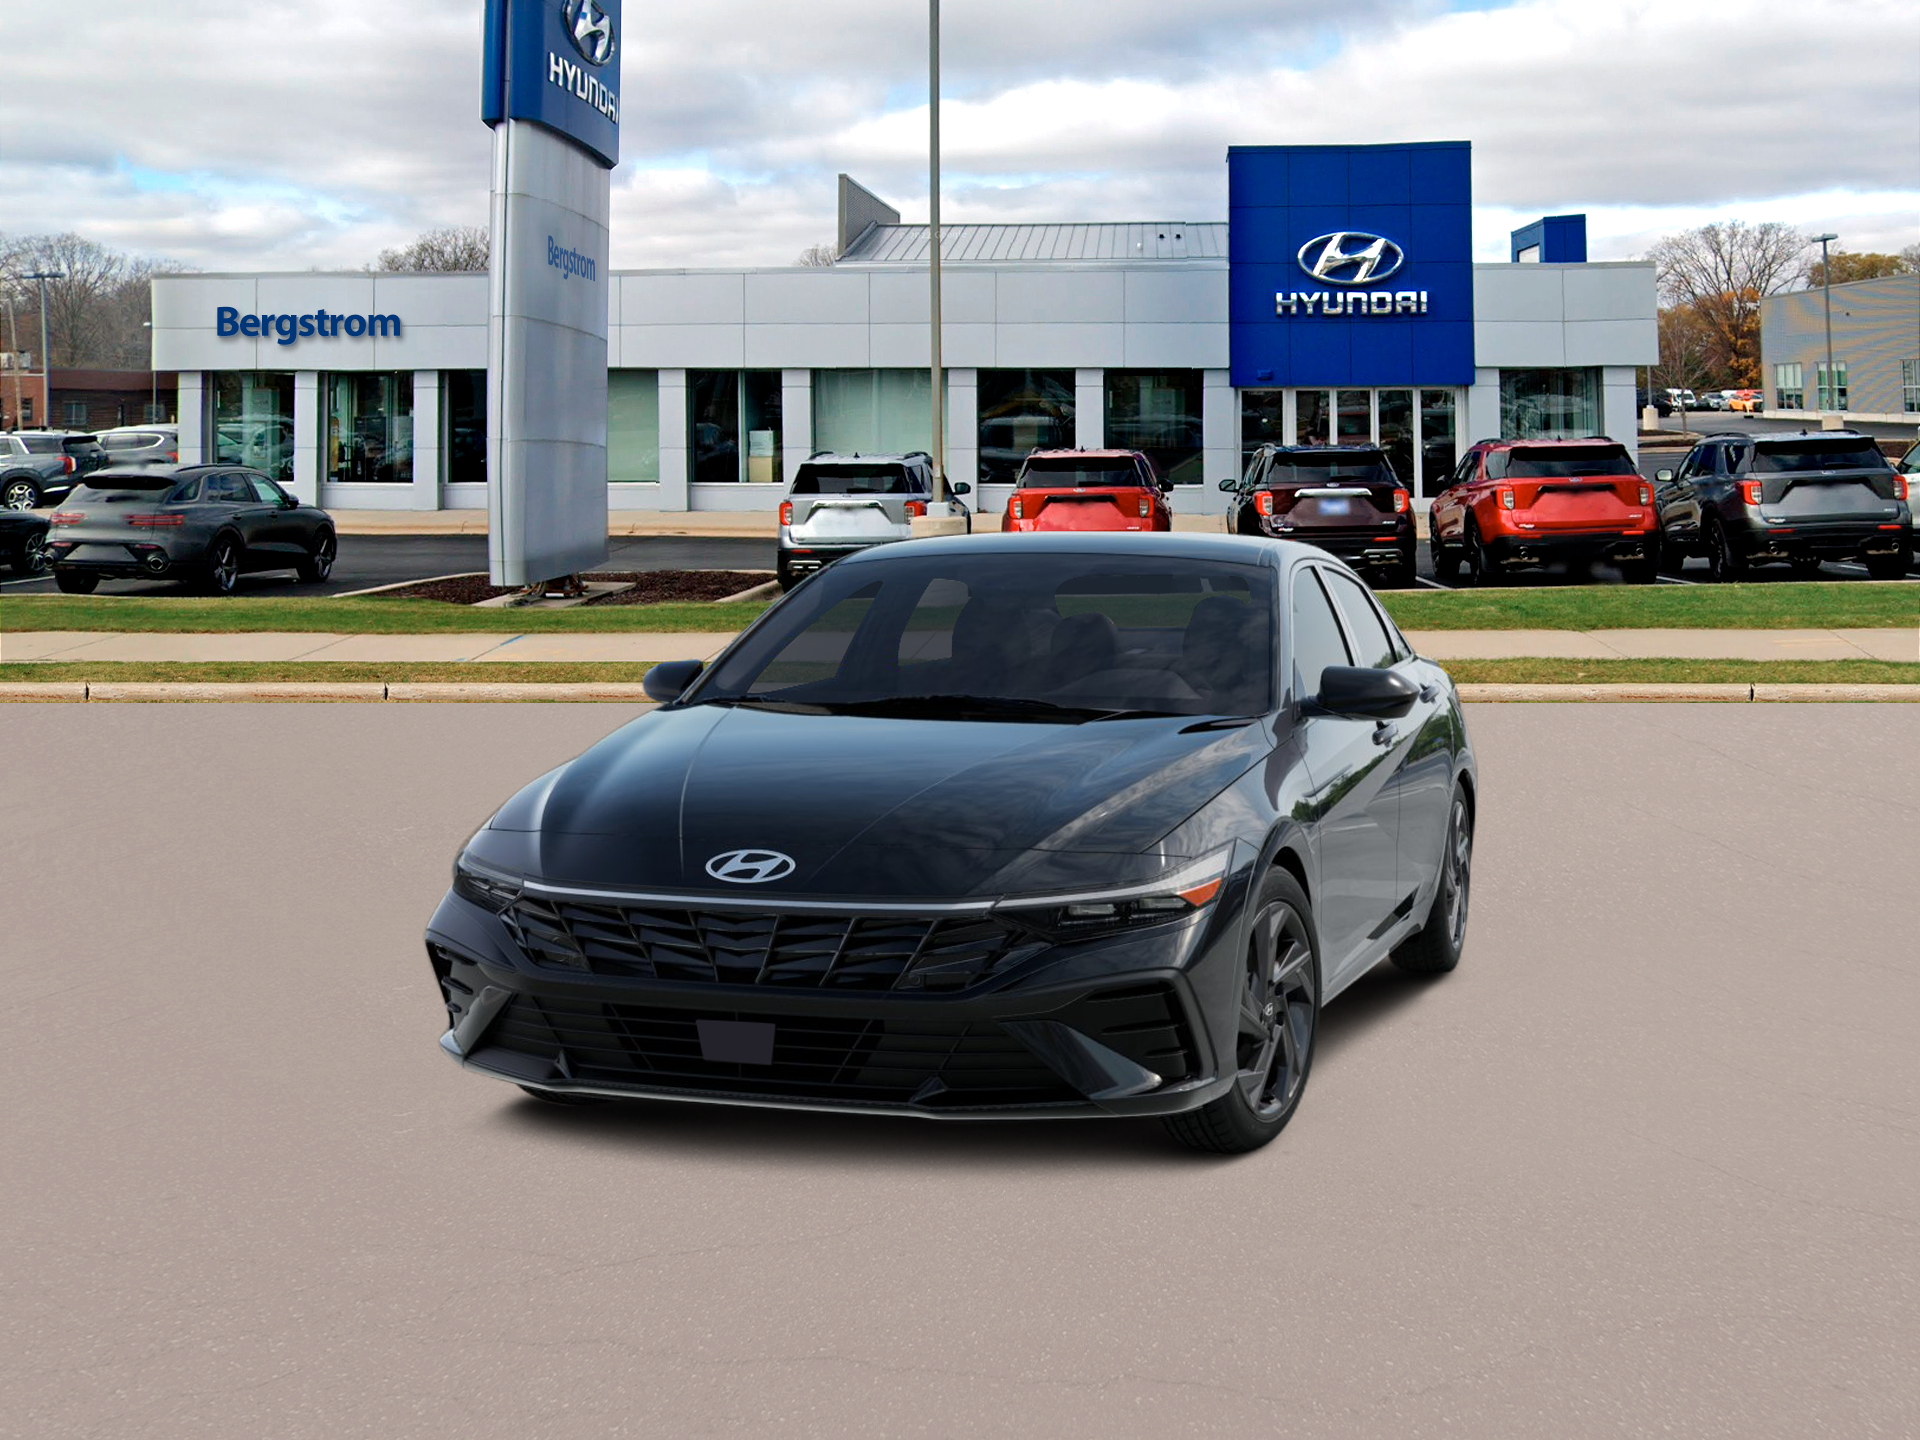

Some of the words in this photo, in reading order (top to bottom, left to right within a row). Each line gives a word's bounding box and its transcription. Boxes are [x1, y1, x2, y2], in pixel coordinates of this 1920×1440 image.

[549, 52, 619, 124] HYUNDAI
[547, 235, 596, 281] Bergstrom
[1275, 291, 1428, 314] HYUNDAI
[217, 306, 401, 345] Bergstrom
